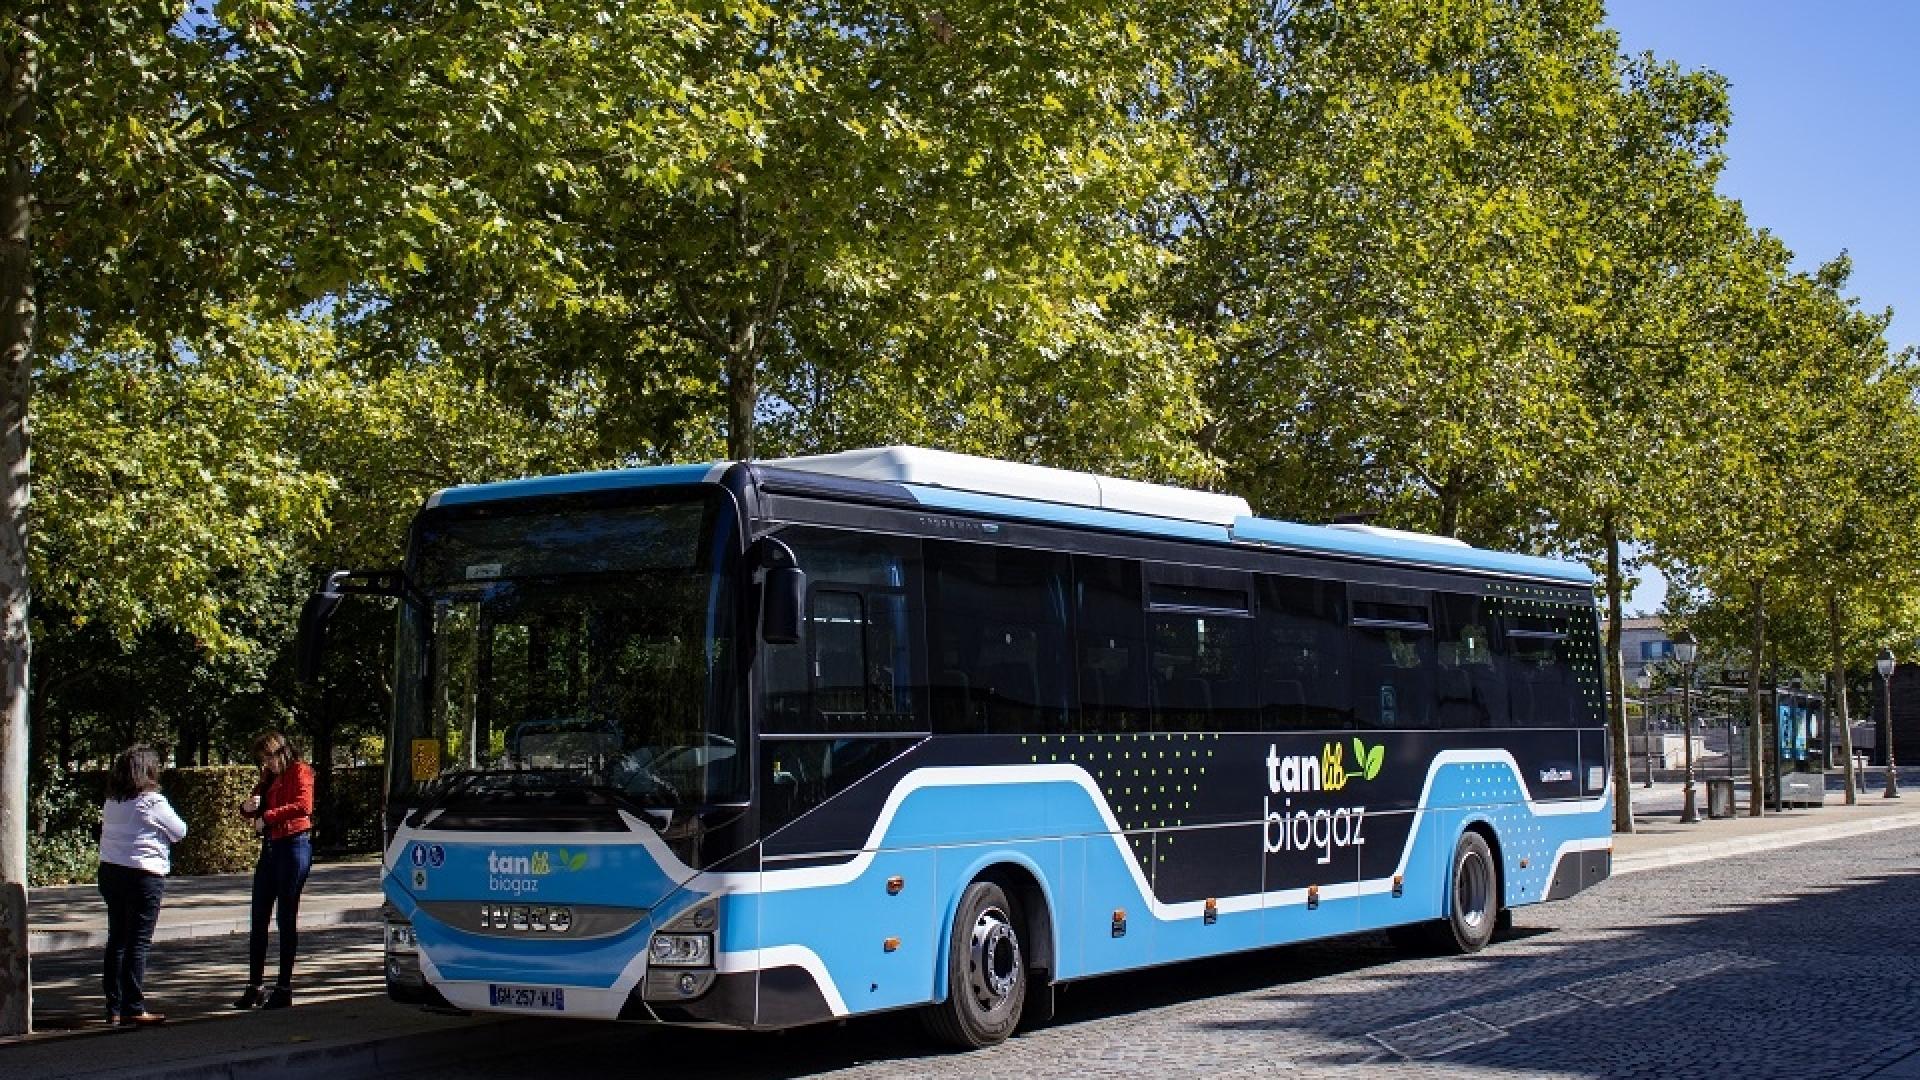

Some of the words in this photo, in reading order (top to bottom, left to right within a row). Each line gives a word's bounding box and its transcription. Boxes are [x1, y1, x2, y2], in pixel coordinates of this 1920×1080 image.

[1263, 795, 1366, 865] biogaz
[489, 874, 538, 896] biogaz
[481, 905, 571, 931] IVECO
